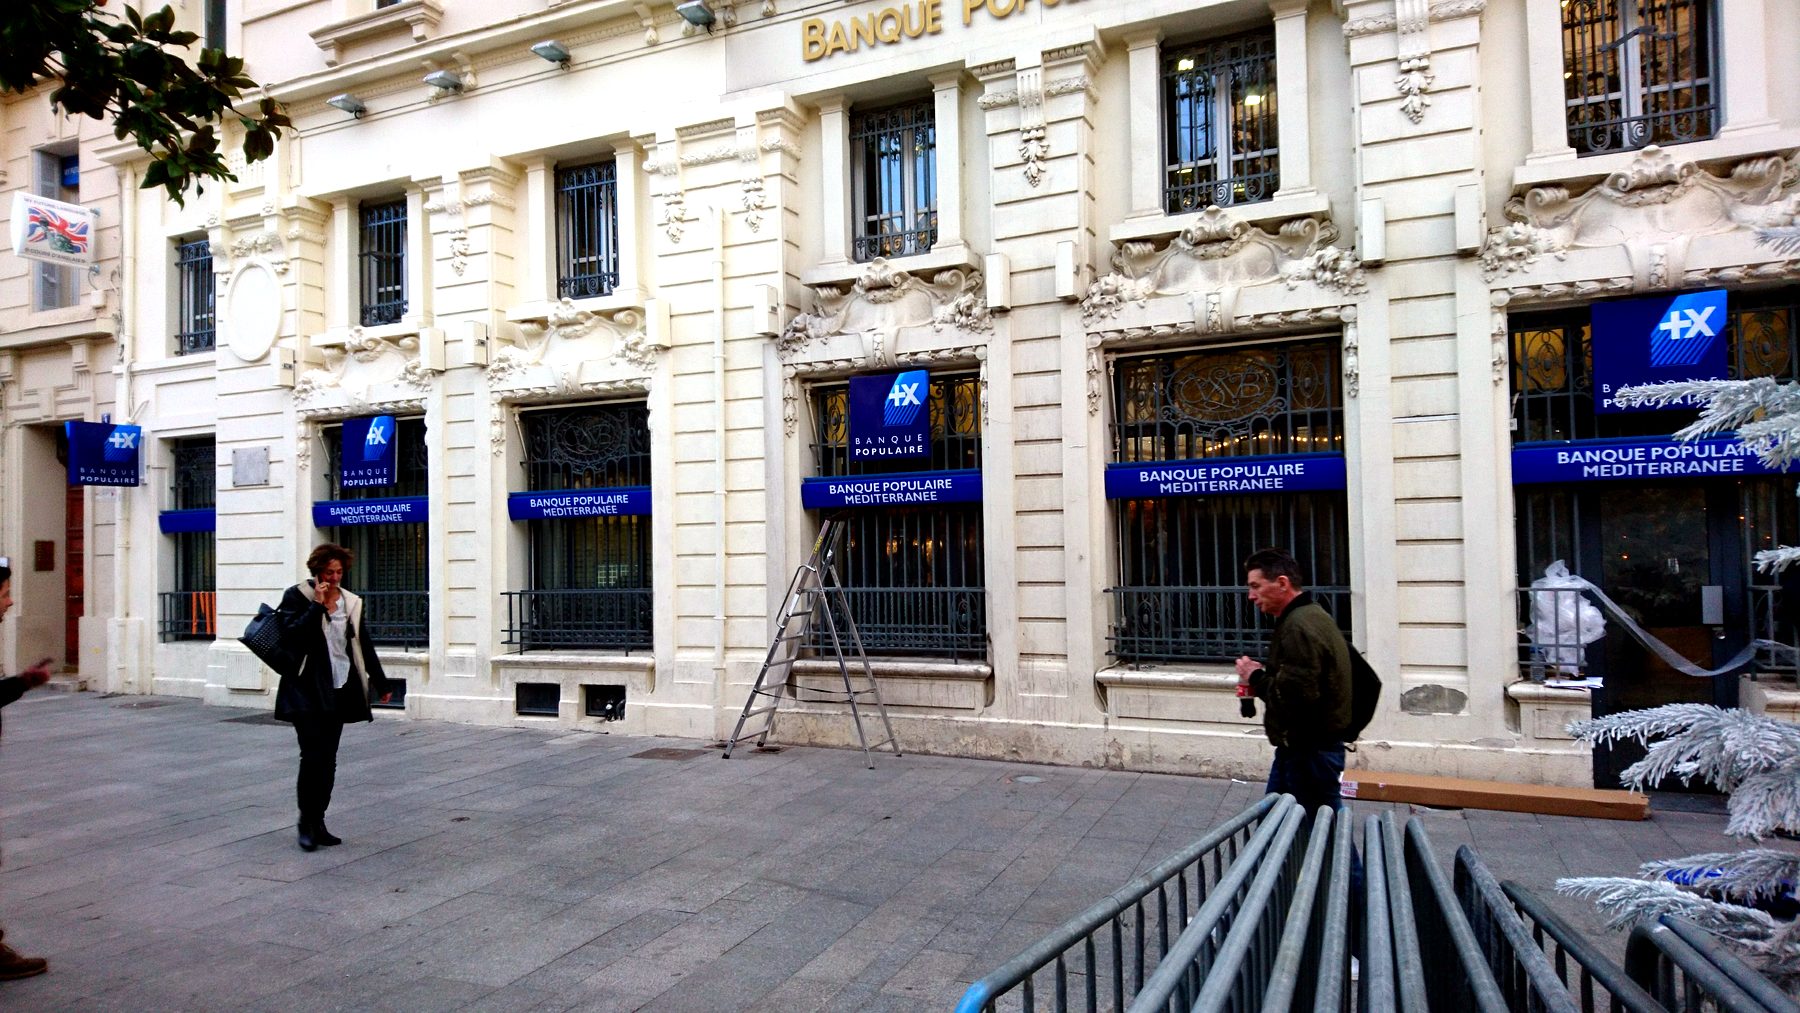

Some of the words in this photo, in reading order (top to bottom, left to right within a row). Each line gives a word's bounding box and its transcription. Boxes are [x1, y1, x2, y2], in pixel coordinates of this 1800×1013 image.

[802, 0, 942, 62] BANQUE
[855, 434, 923, 445] BANQUE
[855, 445, 923, 456] POPULAIRE
[1557, 447, 1646, 464] BANQUE
[1651, 444, 1770, 460] POPULAIR
[80, 467, 134, 476] BANQUE
[343, 468, 387, 477] BANQUE
[1139, 468, 1207, 482] BANQUE
[1211, 463, 1305, 479] POPULAIRE
[1583, 459, 1744, 478] MEDITERRANEE
[80, 475, 135, 484] POPULAIRE
[343, 478, 388, 487] POPULAIRE
[1159, 478, 1284, 494] MEDITERRANEE
[829, 482, 880, 494] BANQUE
[883, 479, 952, 492] POPULAIRE
[530, 497, 571, 508] BANQUE
[573, 494, 629, 506] POPULAIRE
[845, 491, 938, 505] MEDITERRANEE
[330, 506, 364, 516] BANQUE
[365, 503, 411, 514] POPULAIRE
[543, 505, 618, 517] MEDITERRANEE
[341, 513, 403, 524] MEDITERRANEE
